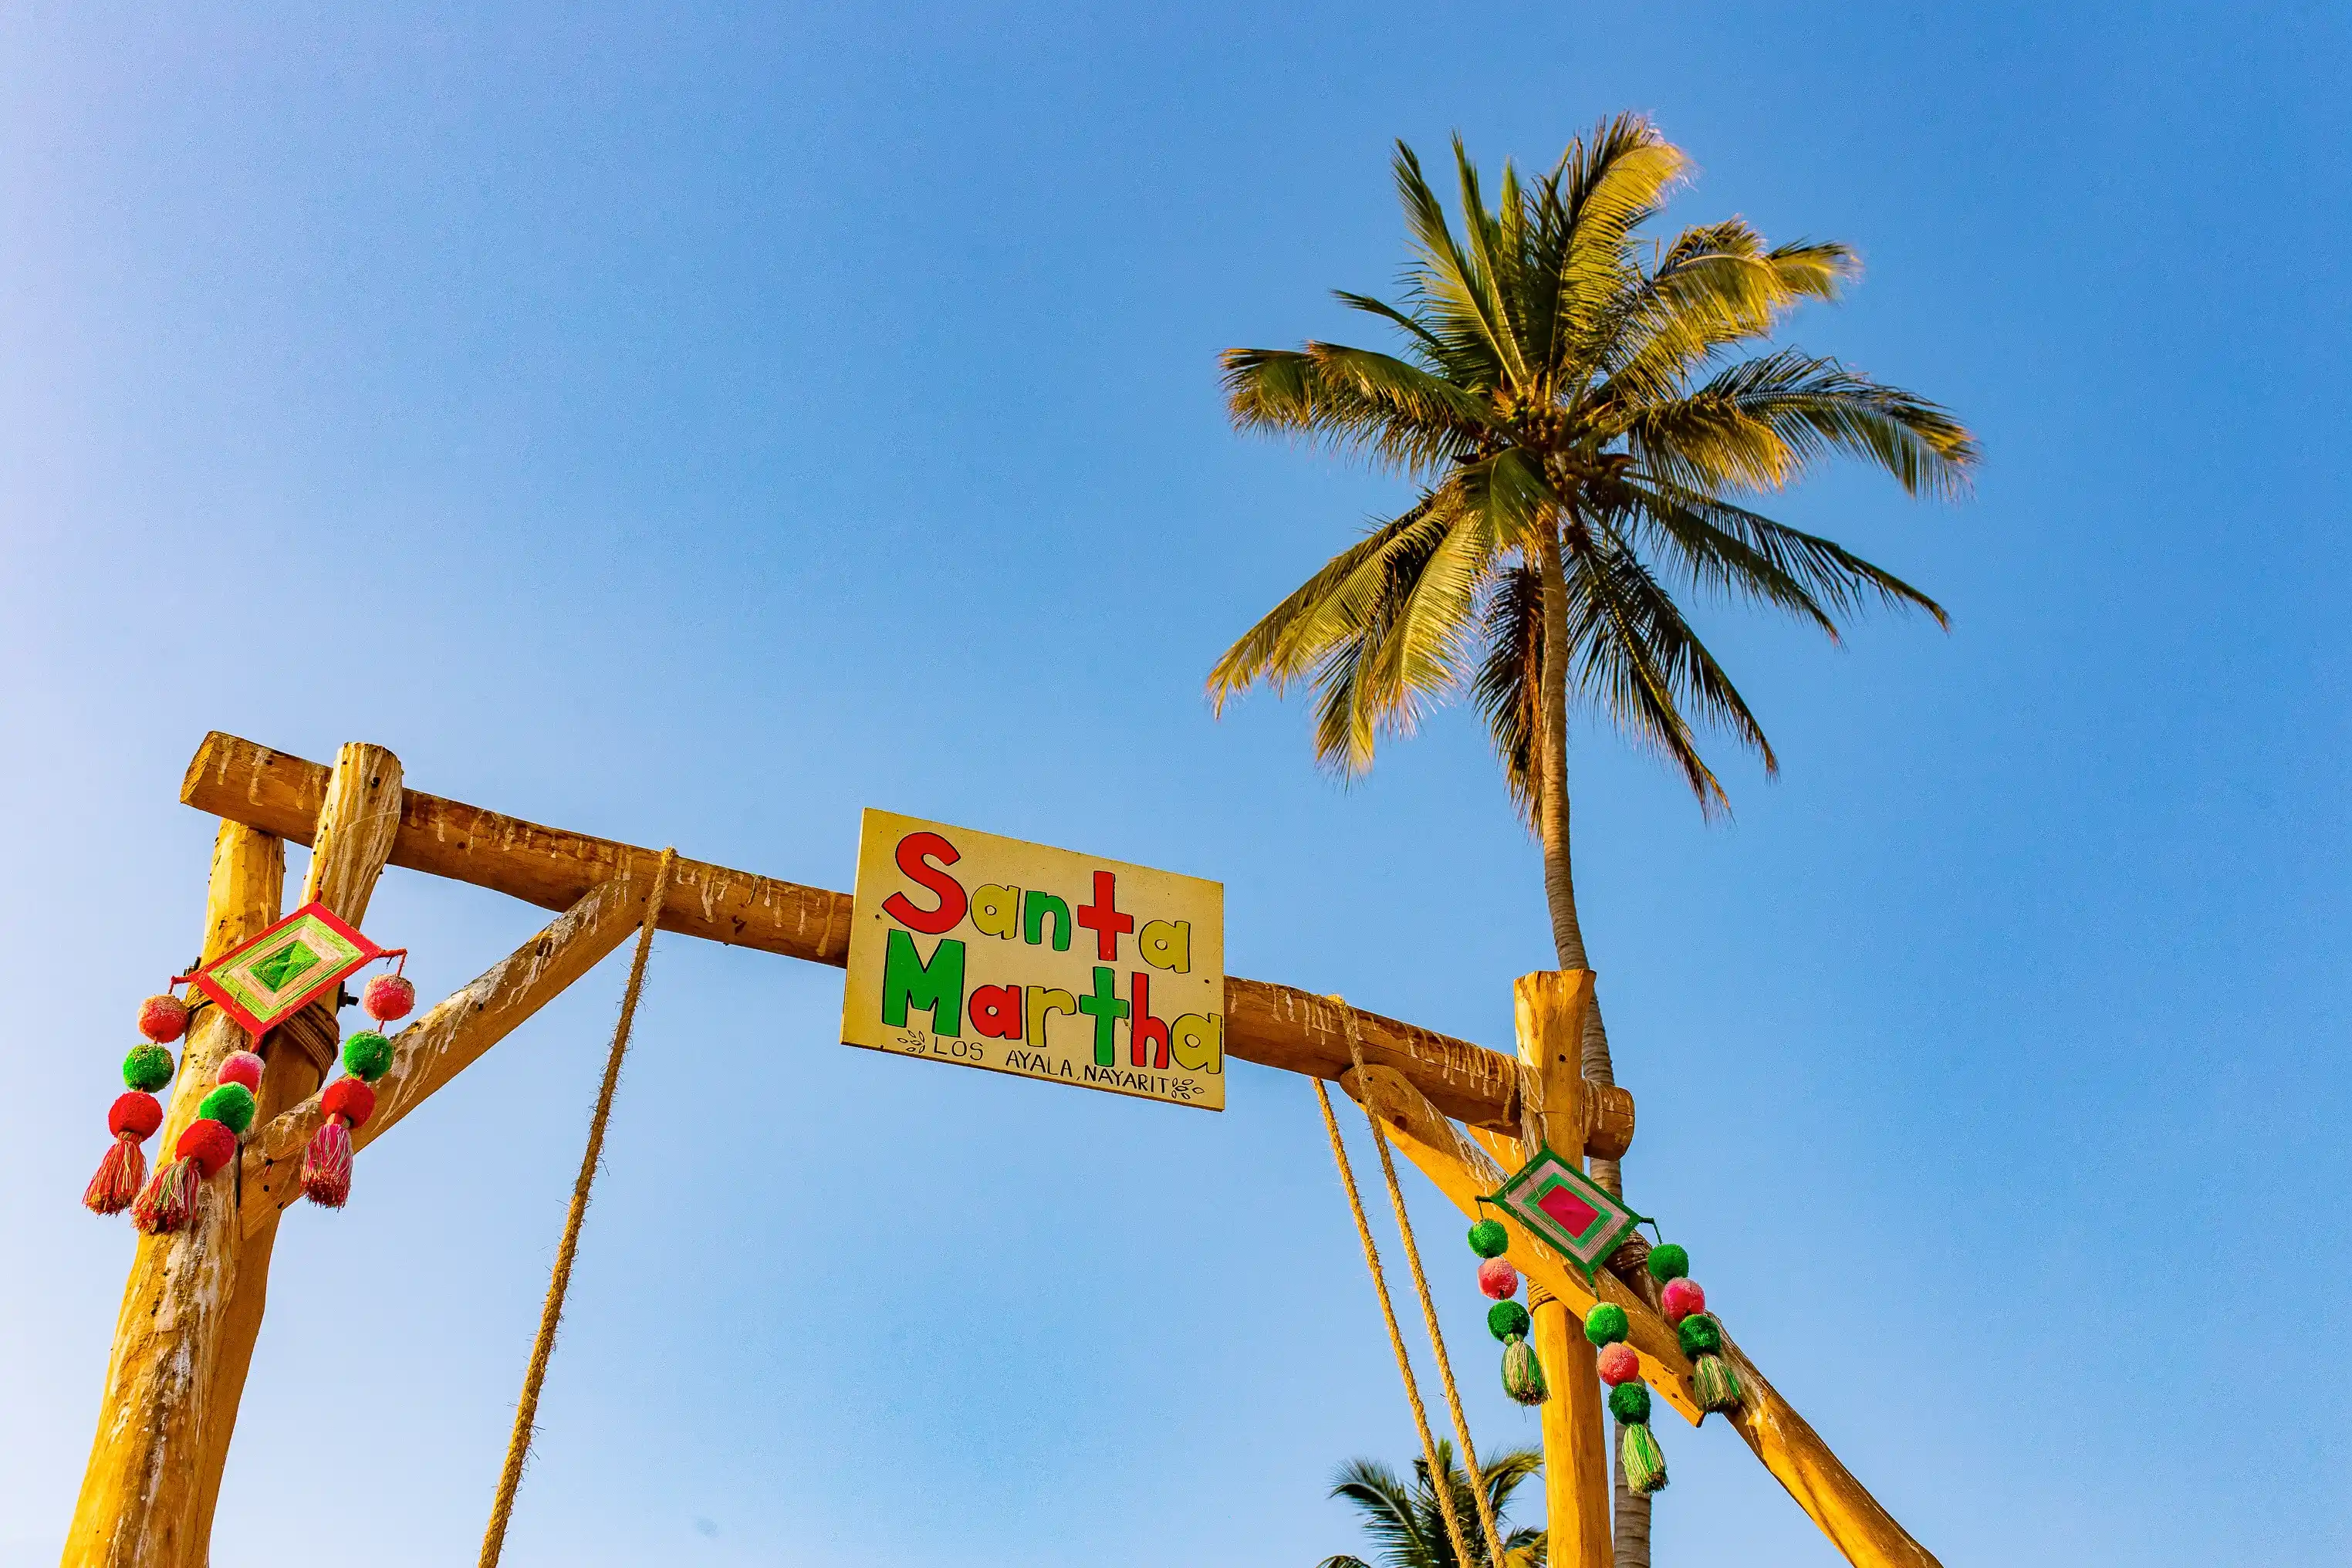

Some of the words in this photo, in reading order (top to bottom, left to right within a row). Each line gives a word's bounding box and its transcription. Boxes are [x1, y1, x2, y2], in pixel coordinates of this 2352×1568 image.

[880, 831, 1191, 974] Santa
[881, 928, 1222, 1074] Martha
[933, 1036, 984, 1061] LOS
